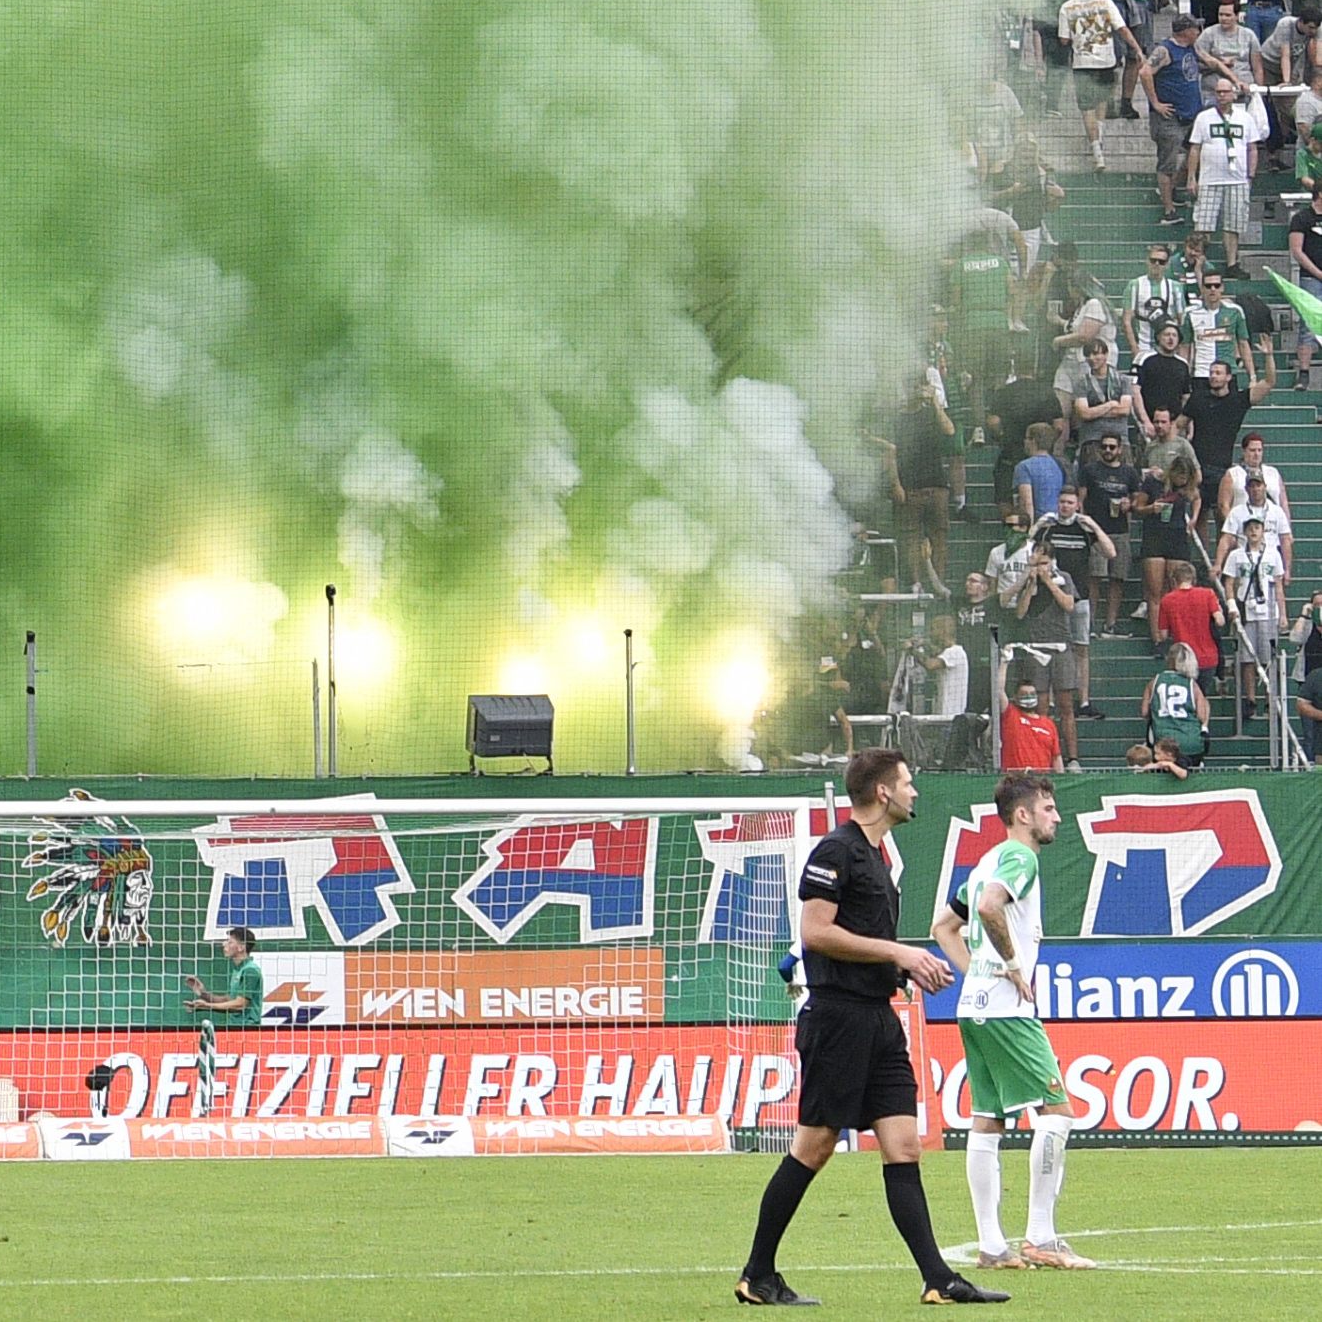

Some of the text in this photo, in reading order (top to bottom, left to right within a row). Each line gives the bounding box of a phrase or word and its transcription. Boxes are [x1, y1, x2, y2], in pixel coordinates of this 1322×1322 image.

[1157, 683, 1188, 718] 12
[362, 988, 465, 1018] WIEN
[480, 986, 645, 1017] ENERGIE
[1035, 963, 1195, 1019] lianz
[230, 1120, 373, 1140] ENERGIE
[574, 1118, 714, 1138] ENERGIE
